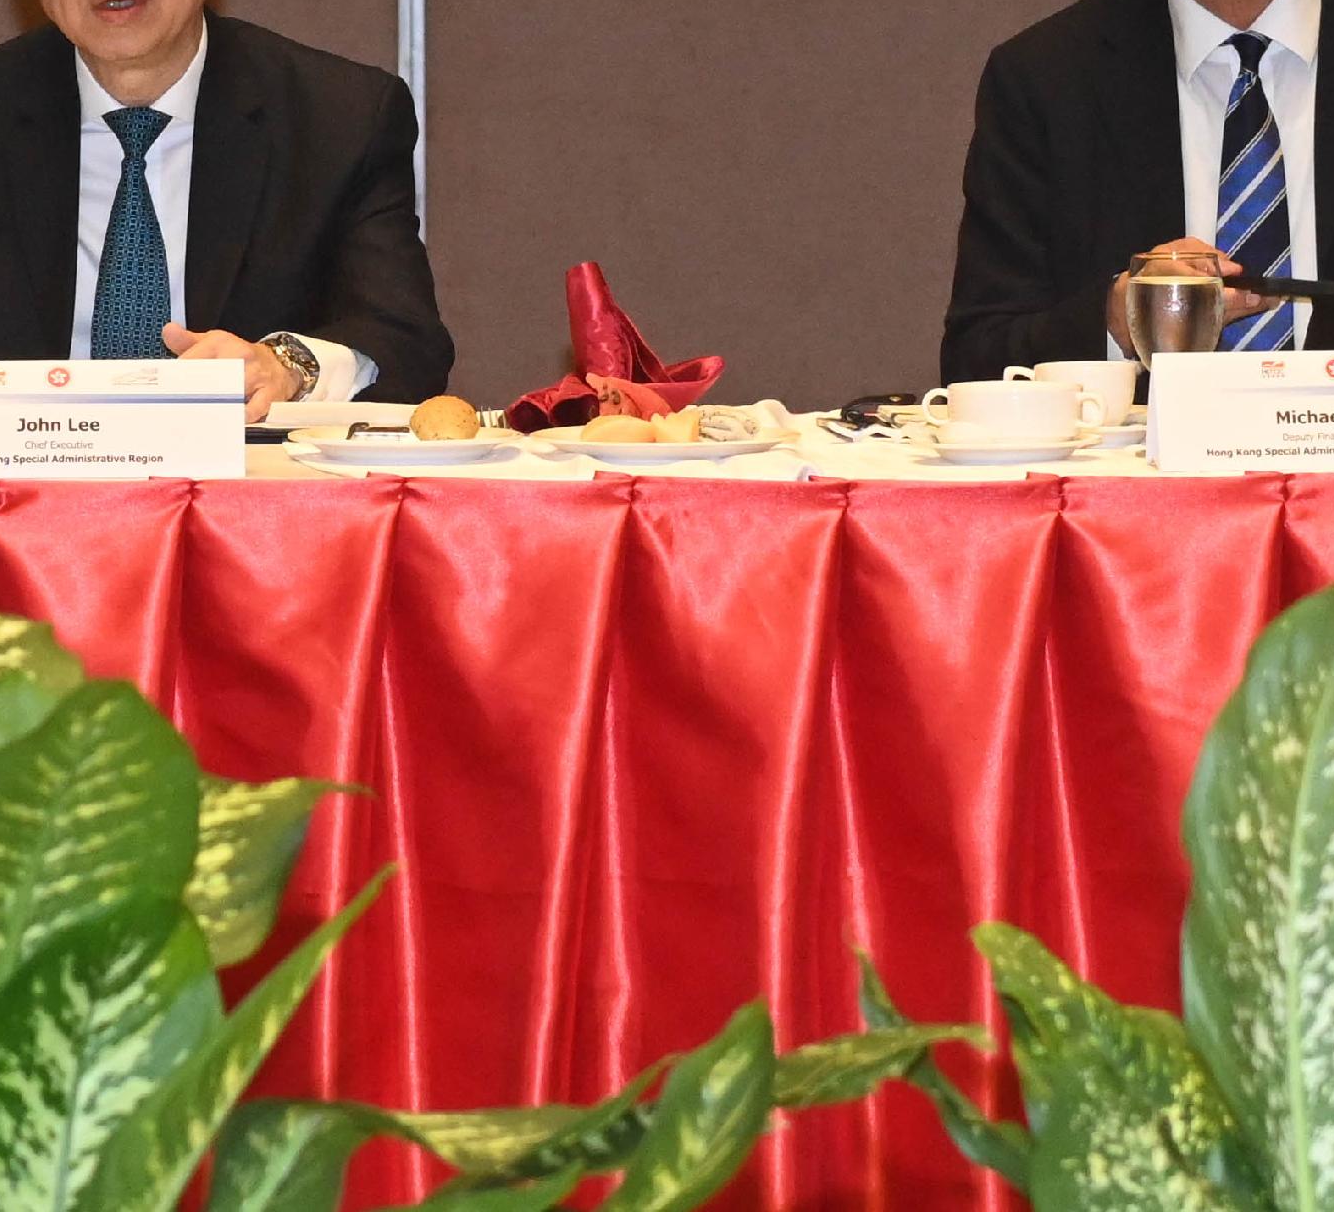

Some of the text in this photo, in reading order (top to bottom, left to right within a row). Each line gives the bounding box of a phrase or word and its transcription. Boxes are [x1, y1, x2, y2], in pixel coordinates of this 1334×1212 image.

[17, 418, 100, 432] John Lee
[1282, 433, 1314, 442] Deputy
[25, 440, 93, 449] Chief Executive
[1207, 448, 1233, 458] Hong
[1236, 448, 1262, 458] Kong
[1265, 447, 1300, 457] Special
[13, 455, 48, 464] Special
[52, 455, 125, 463] Administrative
[129, 454, 164, 464] Region
